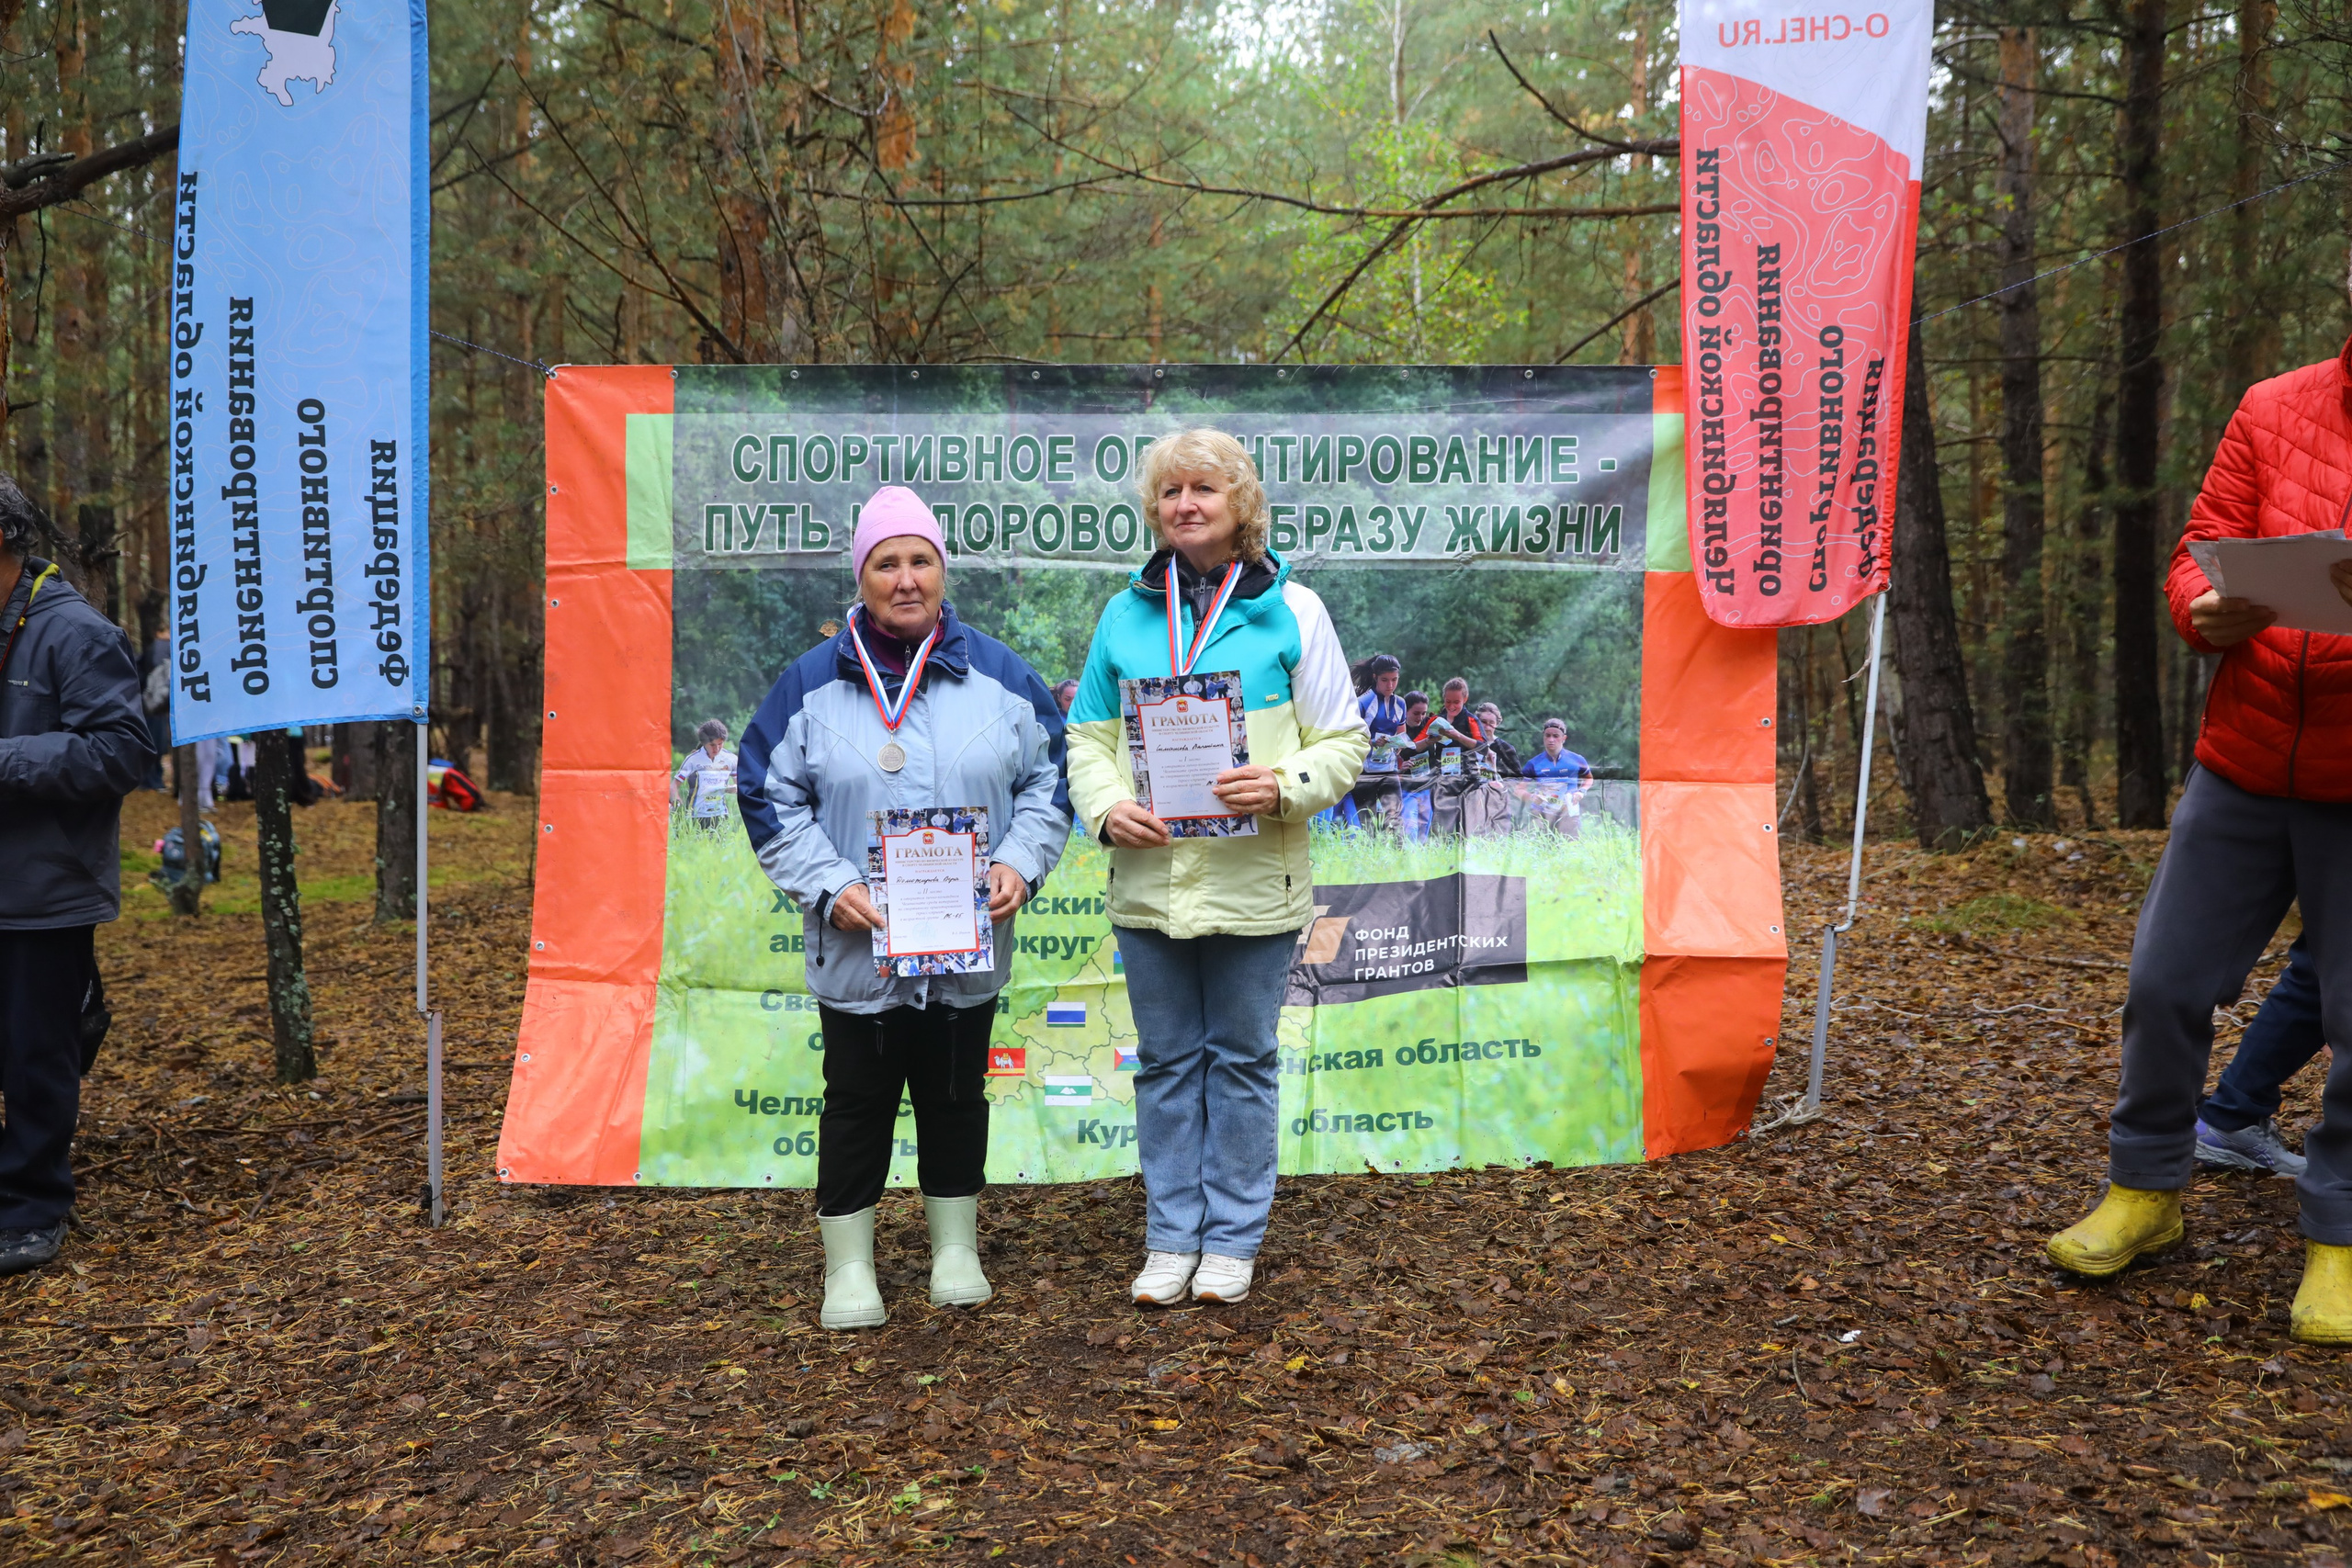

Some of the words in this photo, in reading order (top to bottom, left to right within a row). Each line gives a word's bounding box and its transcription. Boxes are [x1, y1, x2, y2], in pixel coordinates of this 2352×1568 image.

[734, 434, 1075, 483] СПОРТИВНОЕ
[704, 504, 831, 552] ПУТЬ
[1446, 504, 1622, 554] ЖИЗНИ
[1151, 713, 1218, 728] ГРАМОТА
[895, 846, 963, 859] ГРАМОТА
[1354, 926, 1409, 942] ФОНД
[1354, 934, 1508, 962] ПРЕЗИДЕНТСКИХ
[1354, 959, 1435, 981] ГРАНТОВ
[1395, 1038, 1542, 1066] область
[1291, 1109, 1434, 1137] область
